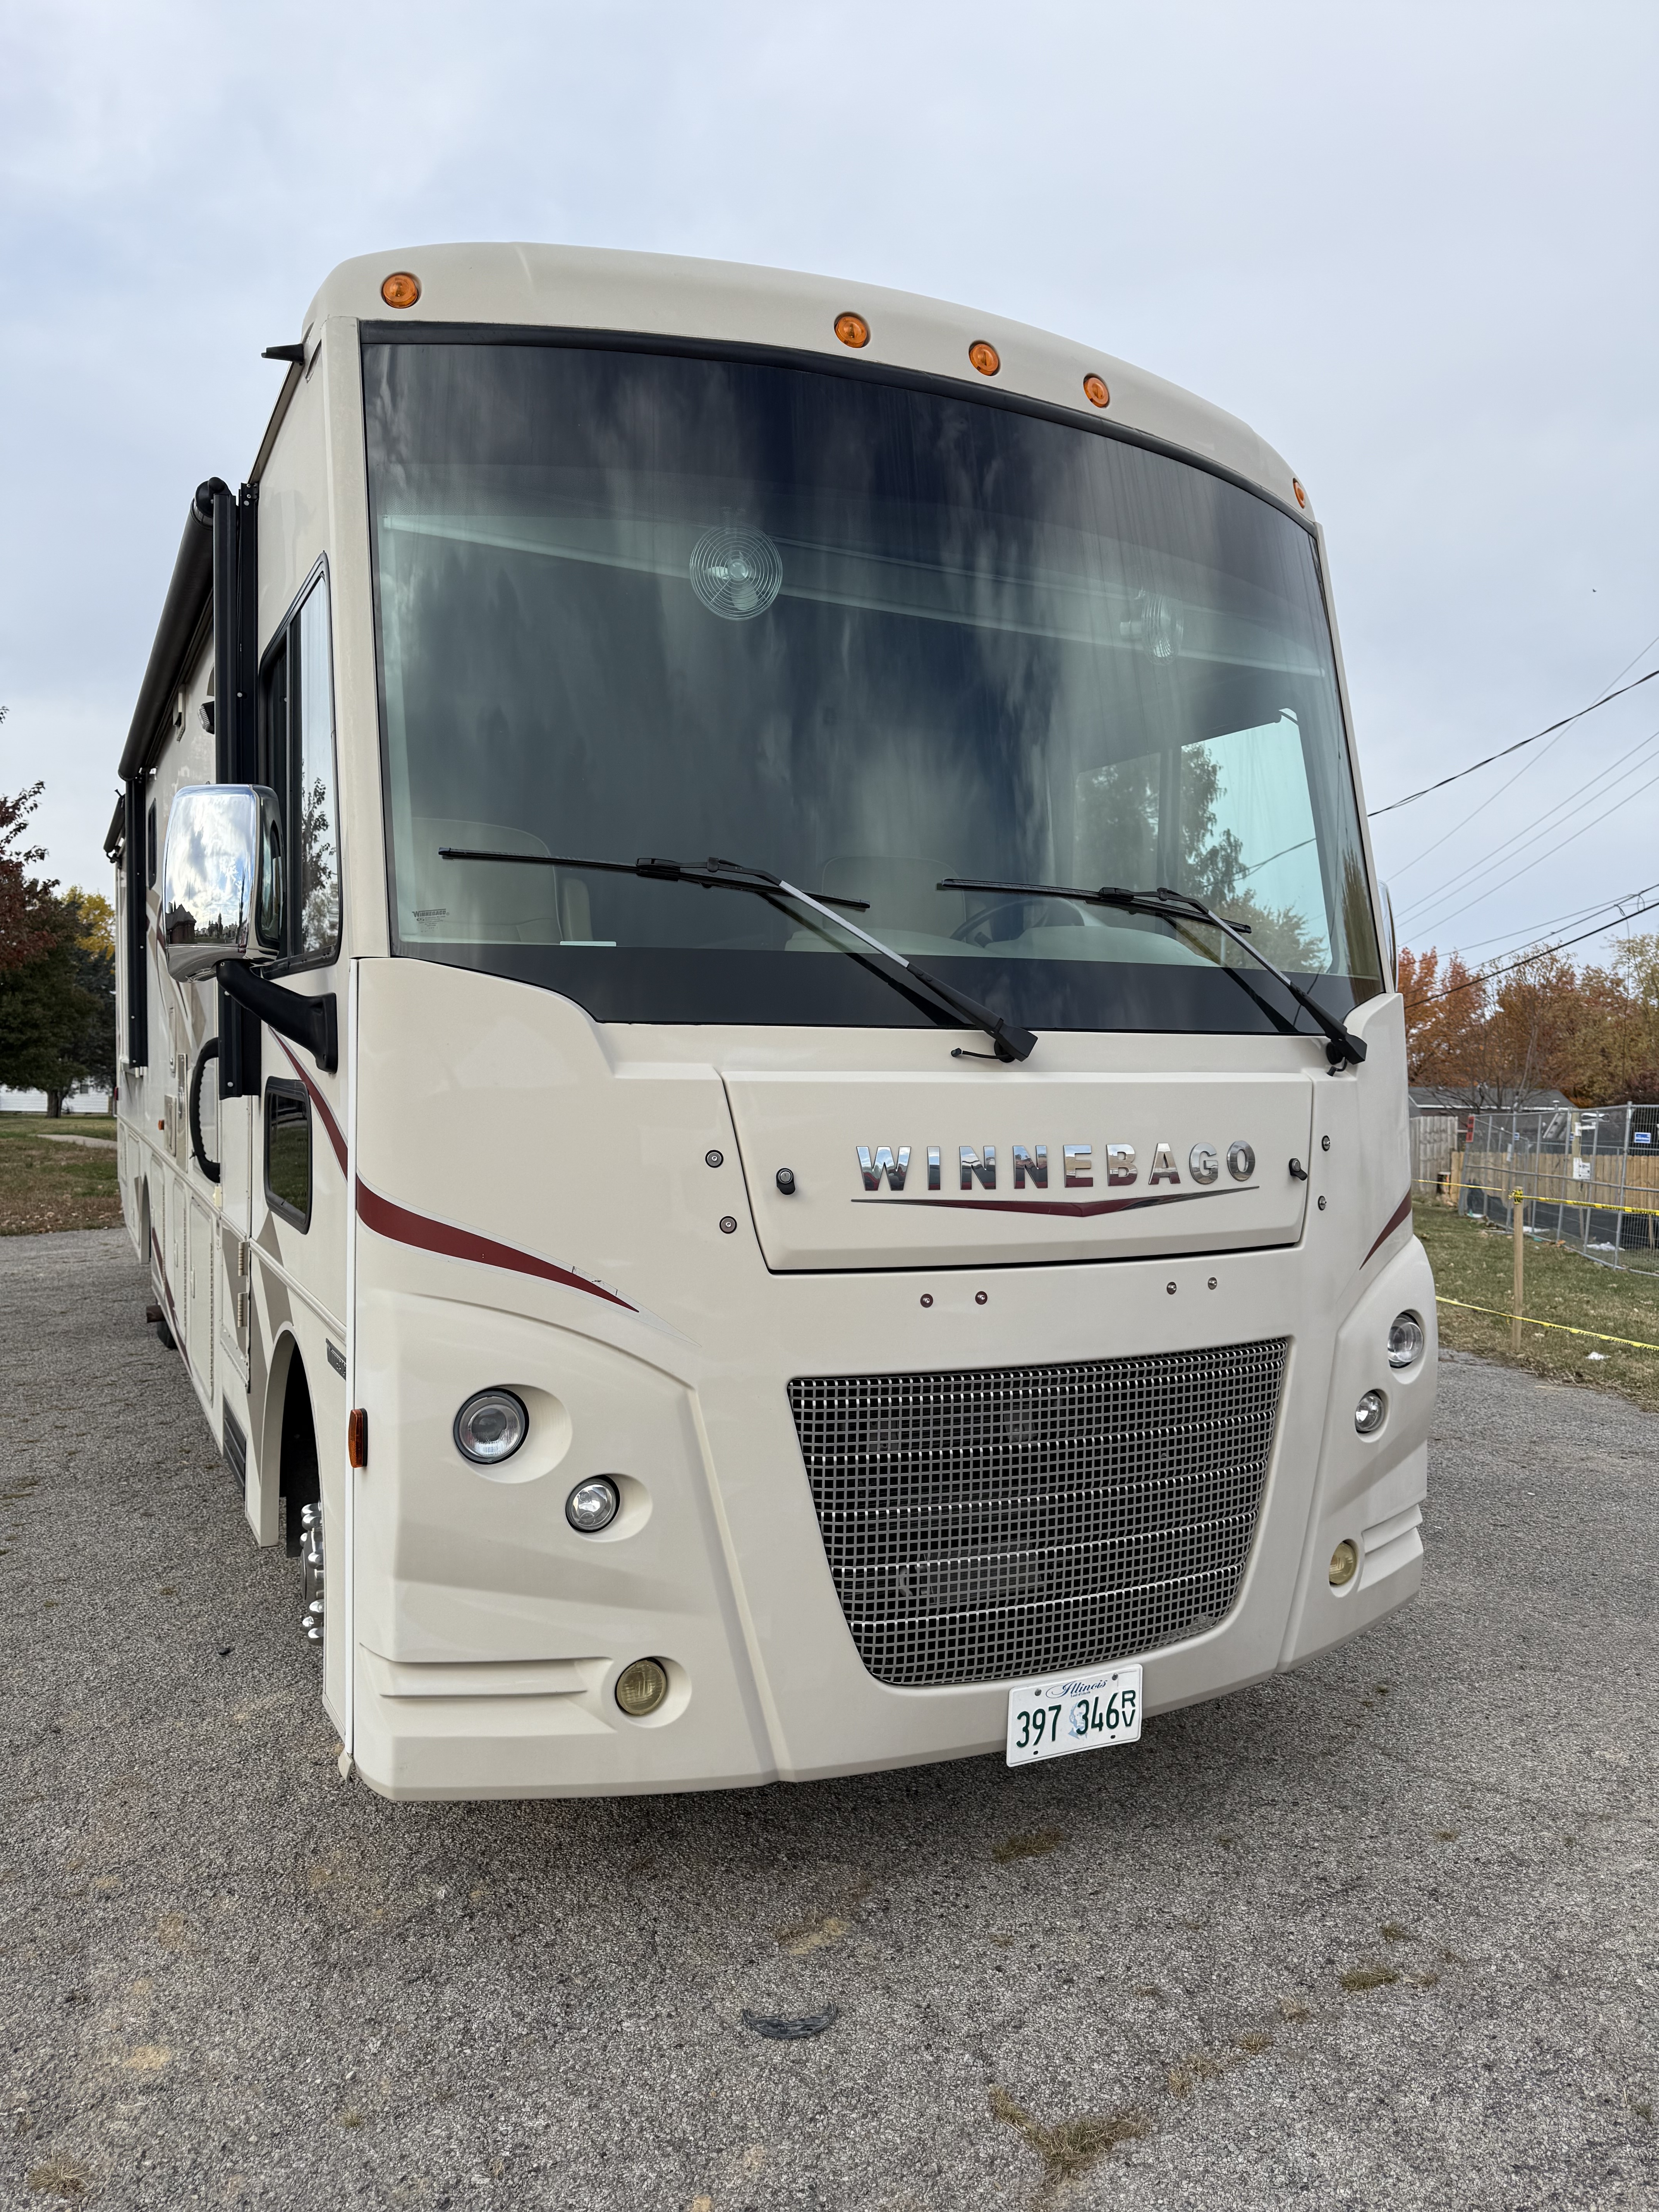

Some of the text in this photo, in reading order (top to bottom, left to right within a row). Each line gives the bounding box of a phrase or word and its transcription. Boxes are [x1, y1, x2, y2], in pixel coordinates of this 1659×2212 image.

[856, 1140, 1255, 1191] WINNEBAGO
[1046, 1680, 1108, 1698] Illinois
[1016, 1692, 1120, 1748] 397 346
